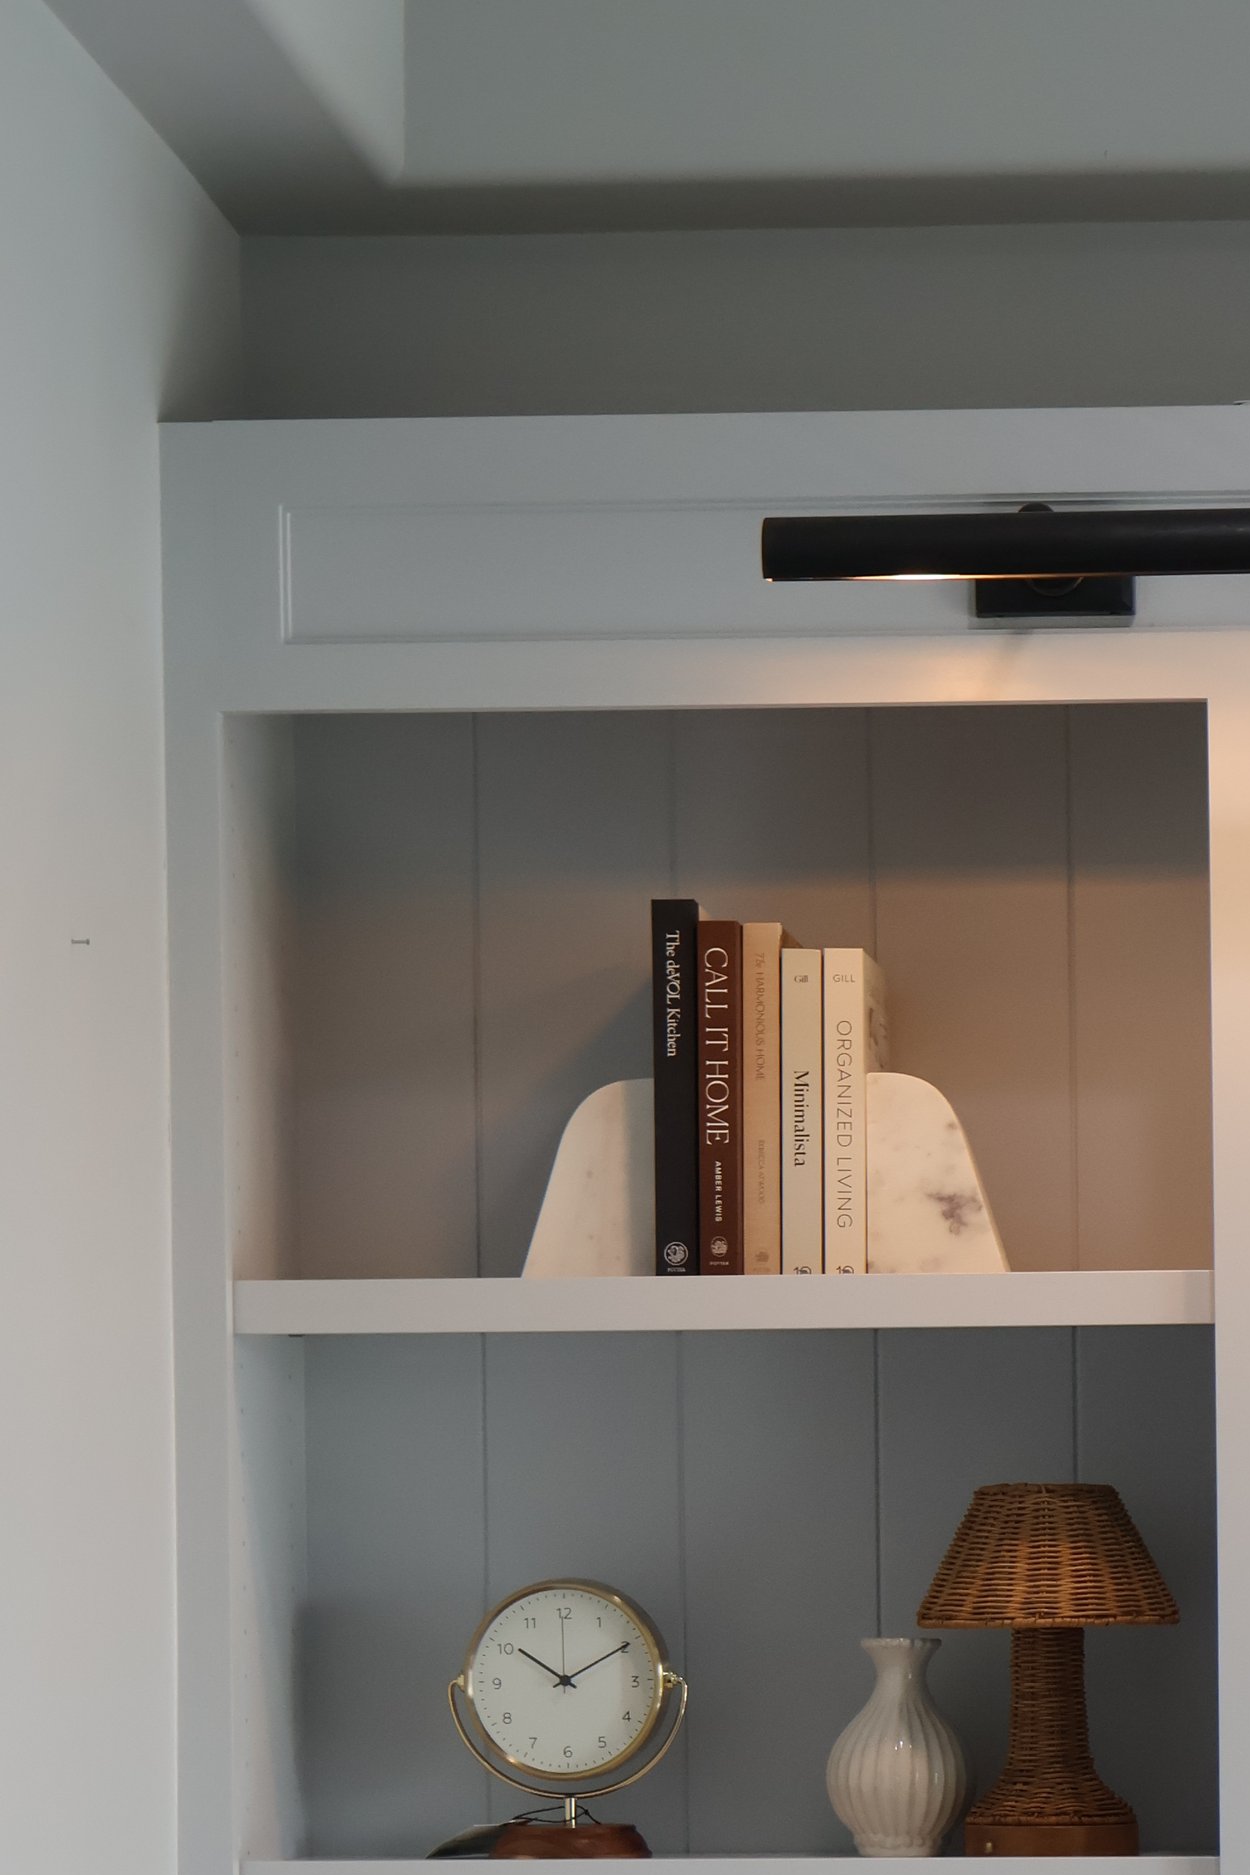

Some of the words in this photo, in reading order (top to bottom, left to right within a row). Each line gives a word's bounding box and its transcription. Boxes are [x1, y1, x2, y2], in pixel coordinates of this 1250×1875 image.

[665, 930, 681, 957] The
[665, 959, 681, 1005] deVOL
[704, 946, 729, 1019] CALL
[793, 974, 809, 984] Gill
[832, 973, 856, 983] GILL
[754, 972, 766, 1046] HARMONIOUS
[666, 1007, 682, 1057] Kitchen
[705, 1027, 729, 1052] IT
[755, 1049, 766, 1080] HOME
[836, 1020, 853, 1148] ORGANIZED
[705, 1060, 731, 1146] HOME
[793, 1070, 811, 1168] Minimalista
[714, 1160, 723, 1193] AMBER
[836, 1156, 853, 1229] LIVING
[714, 1194, 723, 1223] LEWIS
[556, 1607, 573, 1620] 12
[523, 1617, 537, 1629] 11
[596, 1617, 602, 1628] 1
[497, 1642, 514, 1656] 10
[620, 1641, 630, 1654] 2
[492, 1677, 502, 1690] 9
[631, 1675, 640, 1688] 3
[502, 1712, 513, 1725] 8
[621, 1710, 632, 1723] 4
[528, 1737, 537, 1749] 7
[598, 1736, 607, 1749] 5
[563, 1746, 574, 1759] 6
